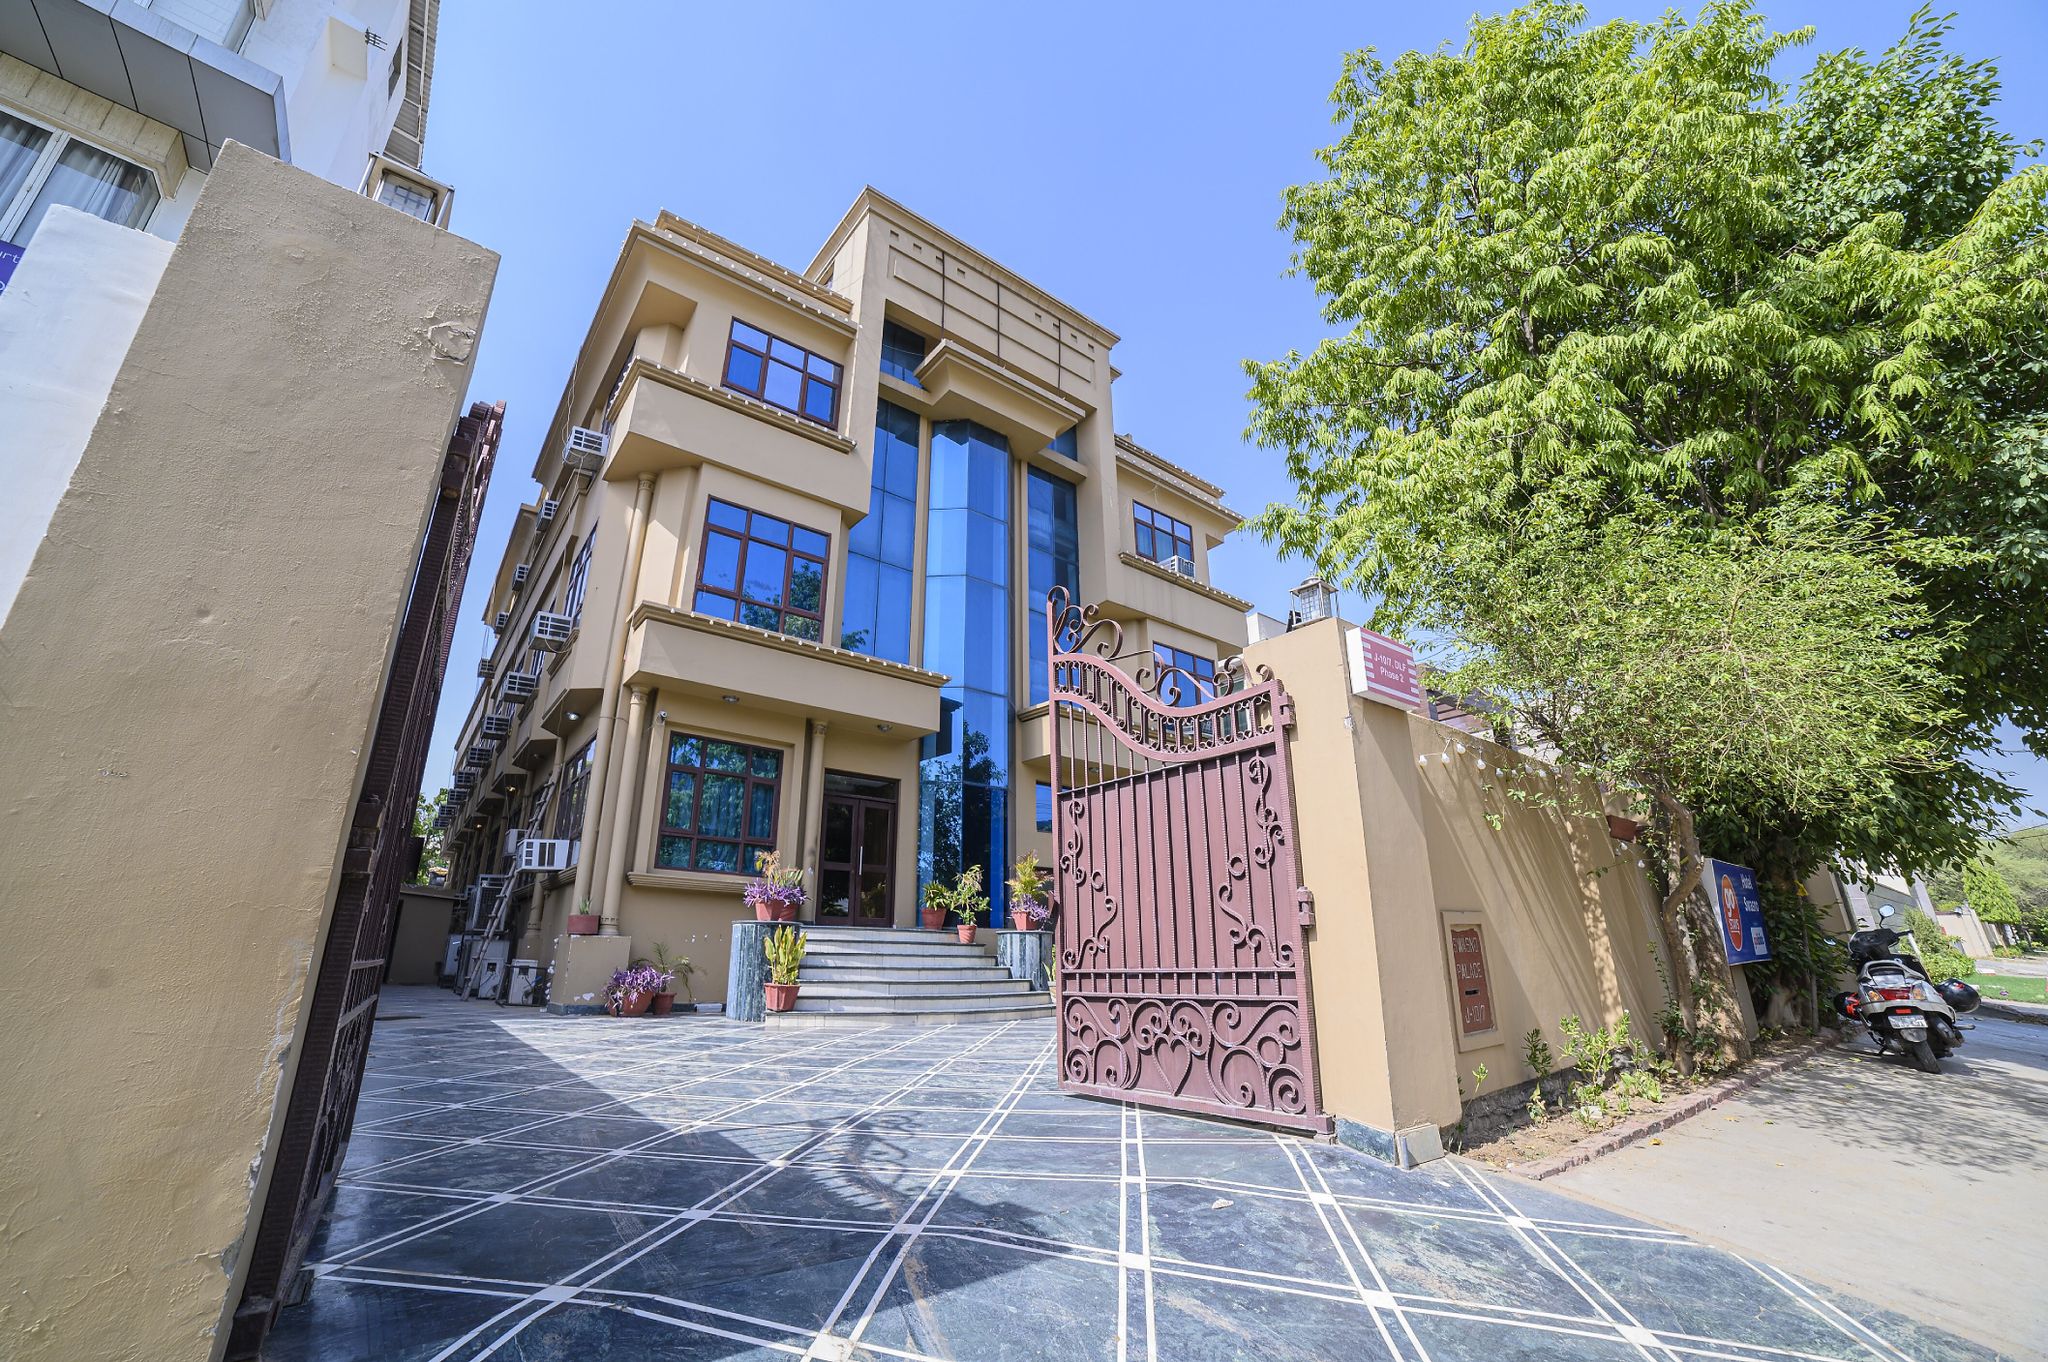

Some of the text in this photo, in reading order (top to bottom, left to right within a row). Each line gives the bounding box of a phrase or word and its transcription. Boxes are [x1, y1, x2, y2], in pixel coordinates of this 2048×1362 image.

[1379, 666, 1405, 683] Phase 2
[1394, 660, 1407, 672] DLF
[1740, 873, 1754, 890] Hotel
[1456, 962, 1483, 980] PALACE
